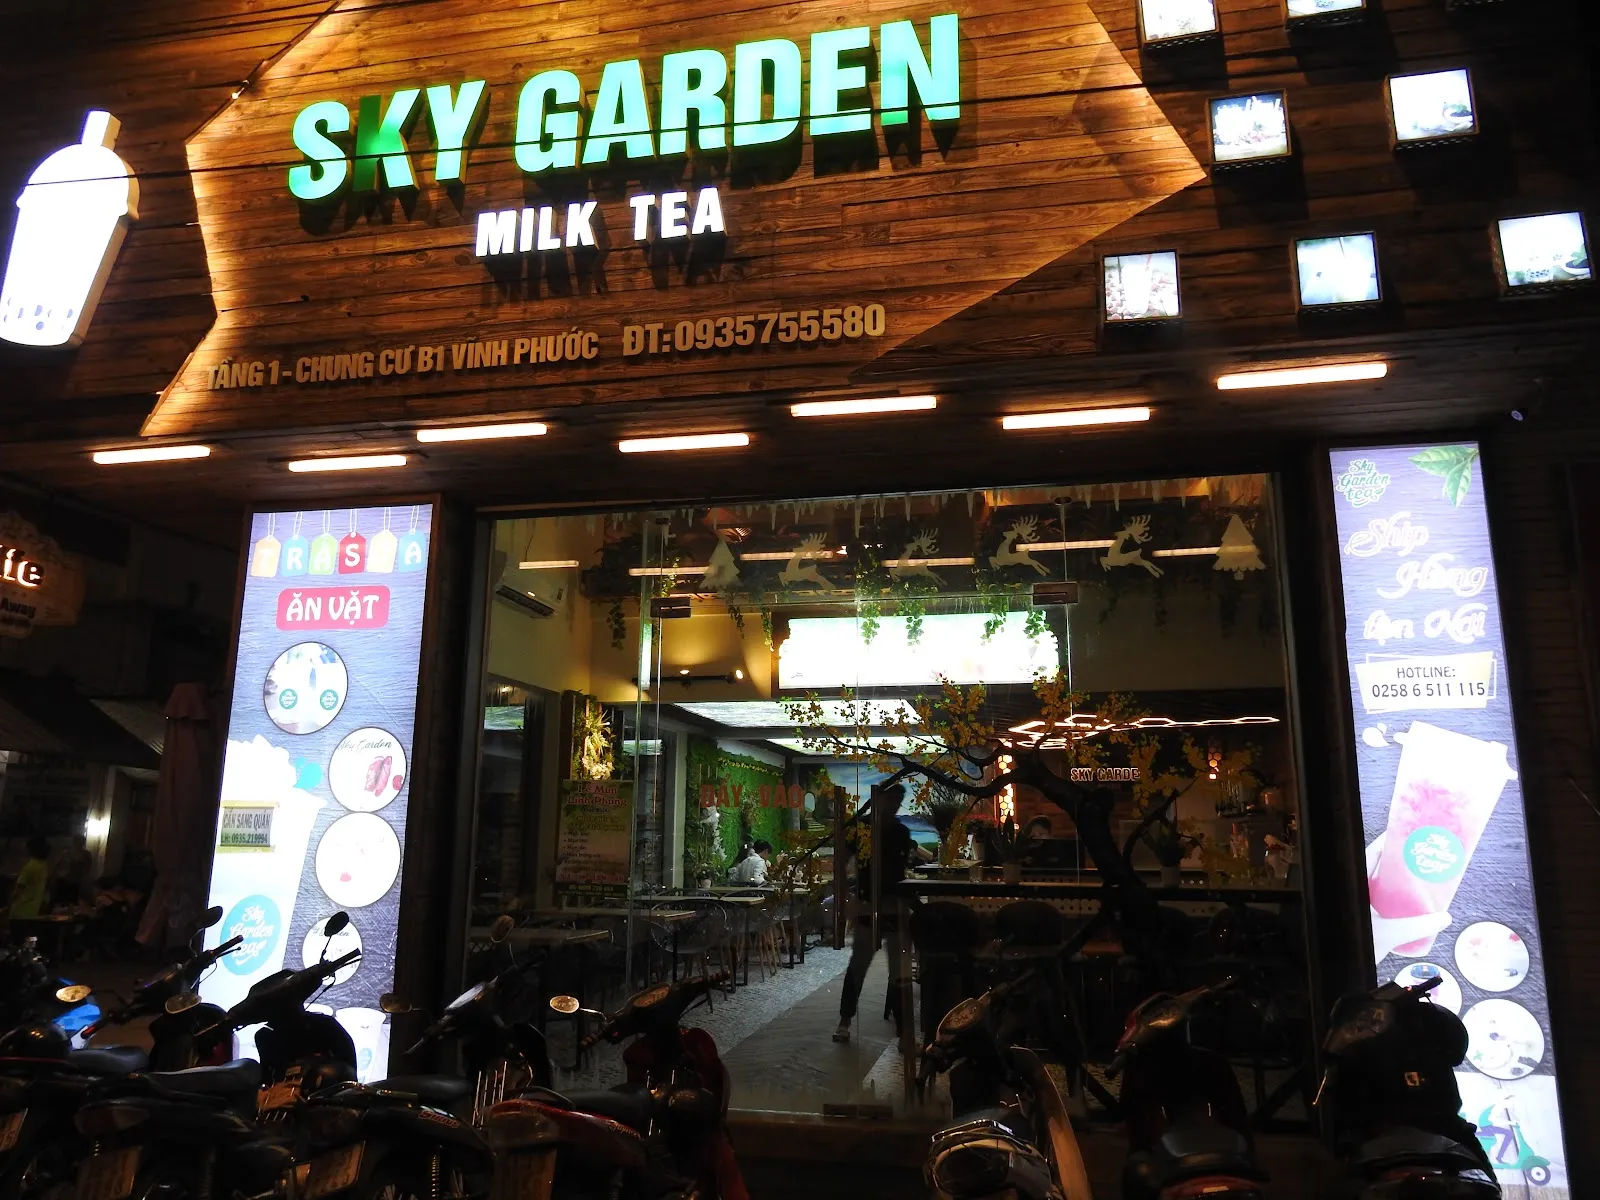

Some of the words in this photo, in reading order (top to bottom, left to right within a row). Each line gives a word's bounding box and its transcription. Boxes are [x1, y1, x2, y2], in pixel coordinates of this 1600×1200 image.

[288, 80, 487, 200] SKY
[513, 13, 961, 174] GARDEN
[474, 201, 598, 258] MILK
[630, 186, 726, 241] TEA
[206, 356, 264, 390] TẦNG
[296, 351, 374, 383] CHUNG
[378, 344, 417, 375] CƯ
[417, 345, 446, 372] B1
[451, 336, 507, 371] VĨNH
[514, 326, 600, 364] PHƯỚC
[286, 592, 322, 622] ĂN
[328, 590, 380, 625] VẶT
[1372, 683, 1408, 698] 0258
[1412, 683, 1422, 697] 6
[1425, 683, 1452, 697] 511
[1459, 682, 1486, 697] 115
[1396, 666, 1457, 680] HOTLINE:
[1070, 767, 1094, 782] SKY
